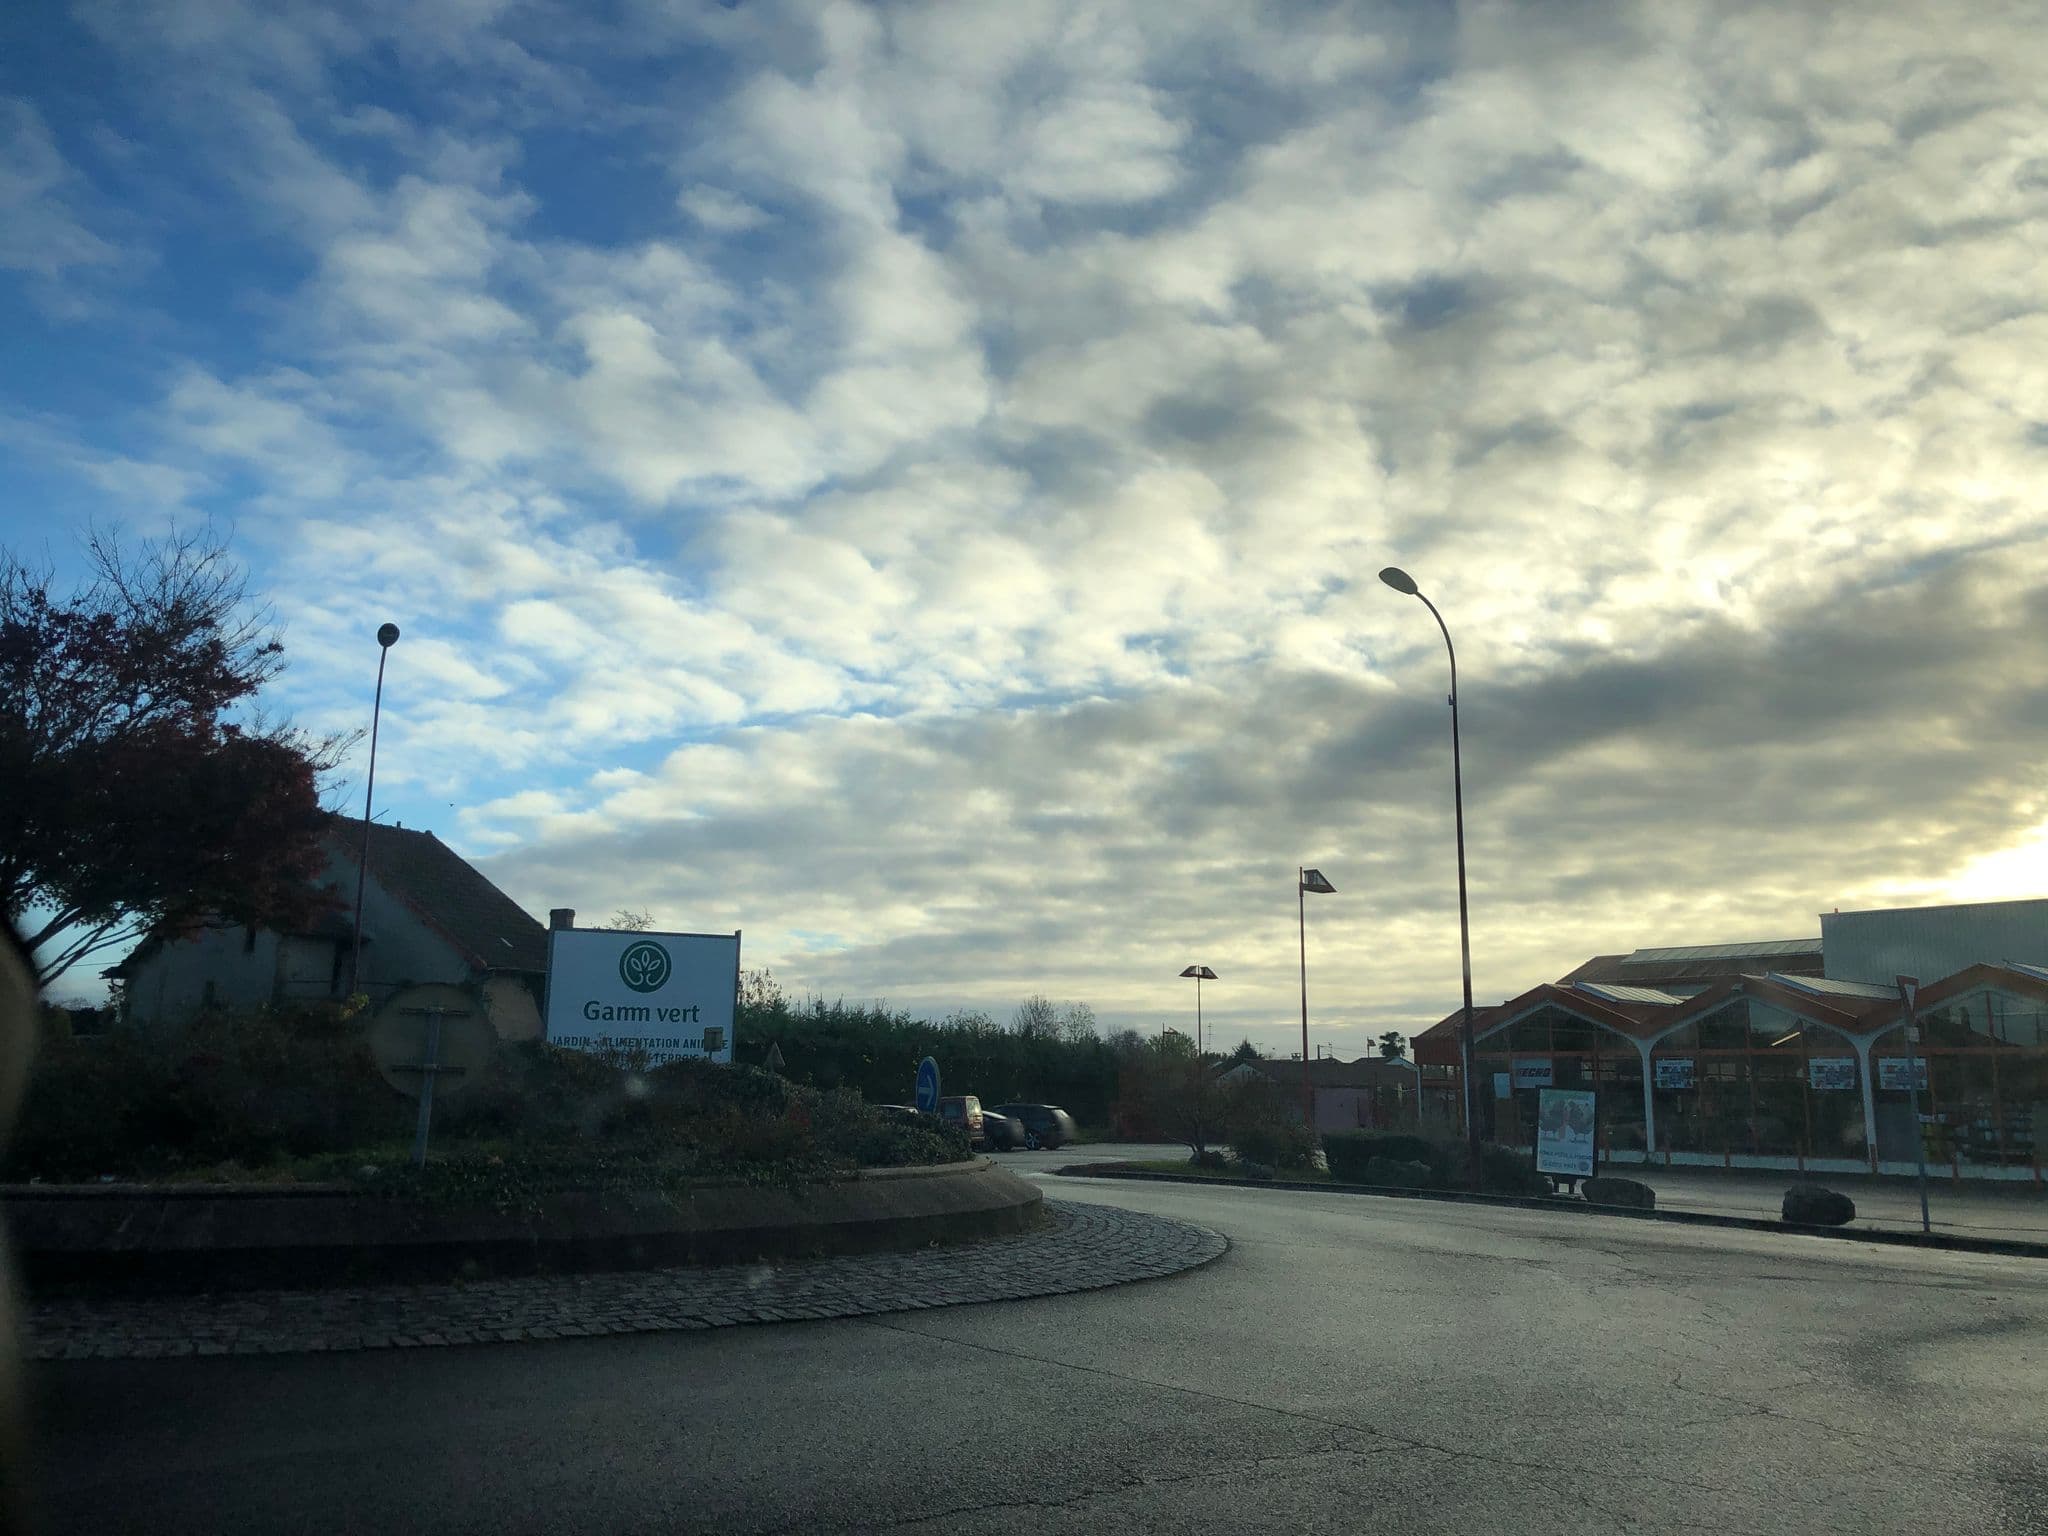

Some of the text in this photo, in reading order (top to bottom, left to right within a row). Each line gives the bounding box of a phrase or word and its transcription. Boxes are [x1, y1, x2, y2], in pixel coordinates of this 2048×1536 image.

[583, 1000, 700, 1023] Gamm vert
[553, 1036, 728, 1049] JARDIN LIMENTATION ANIE
